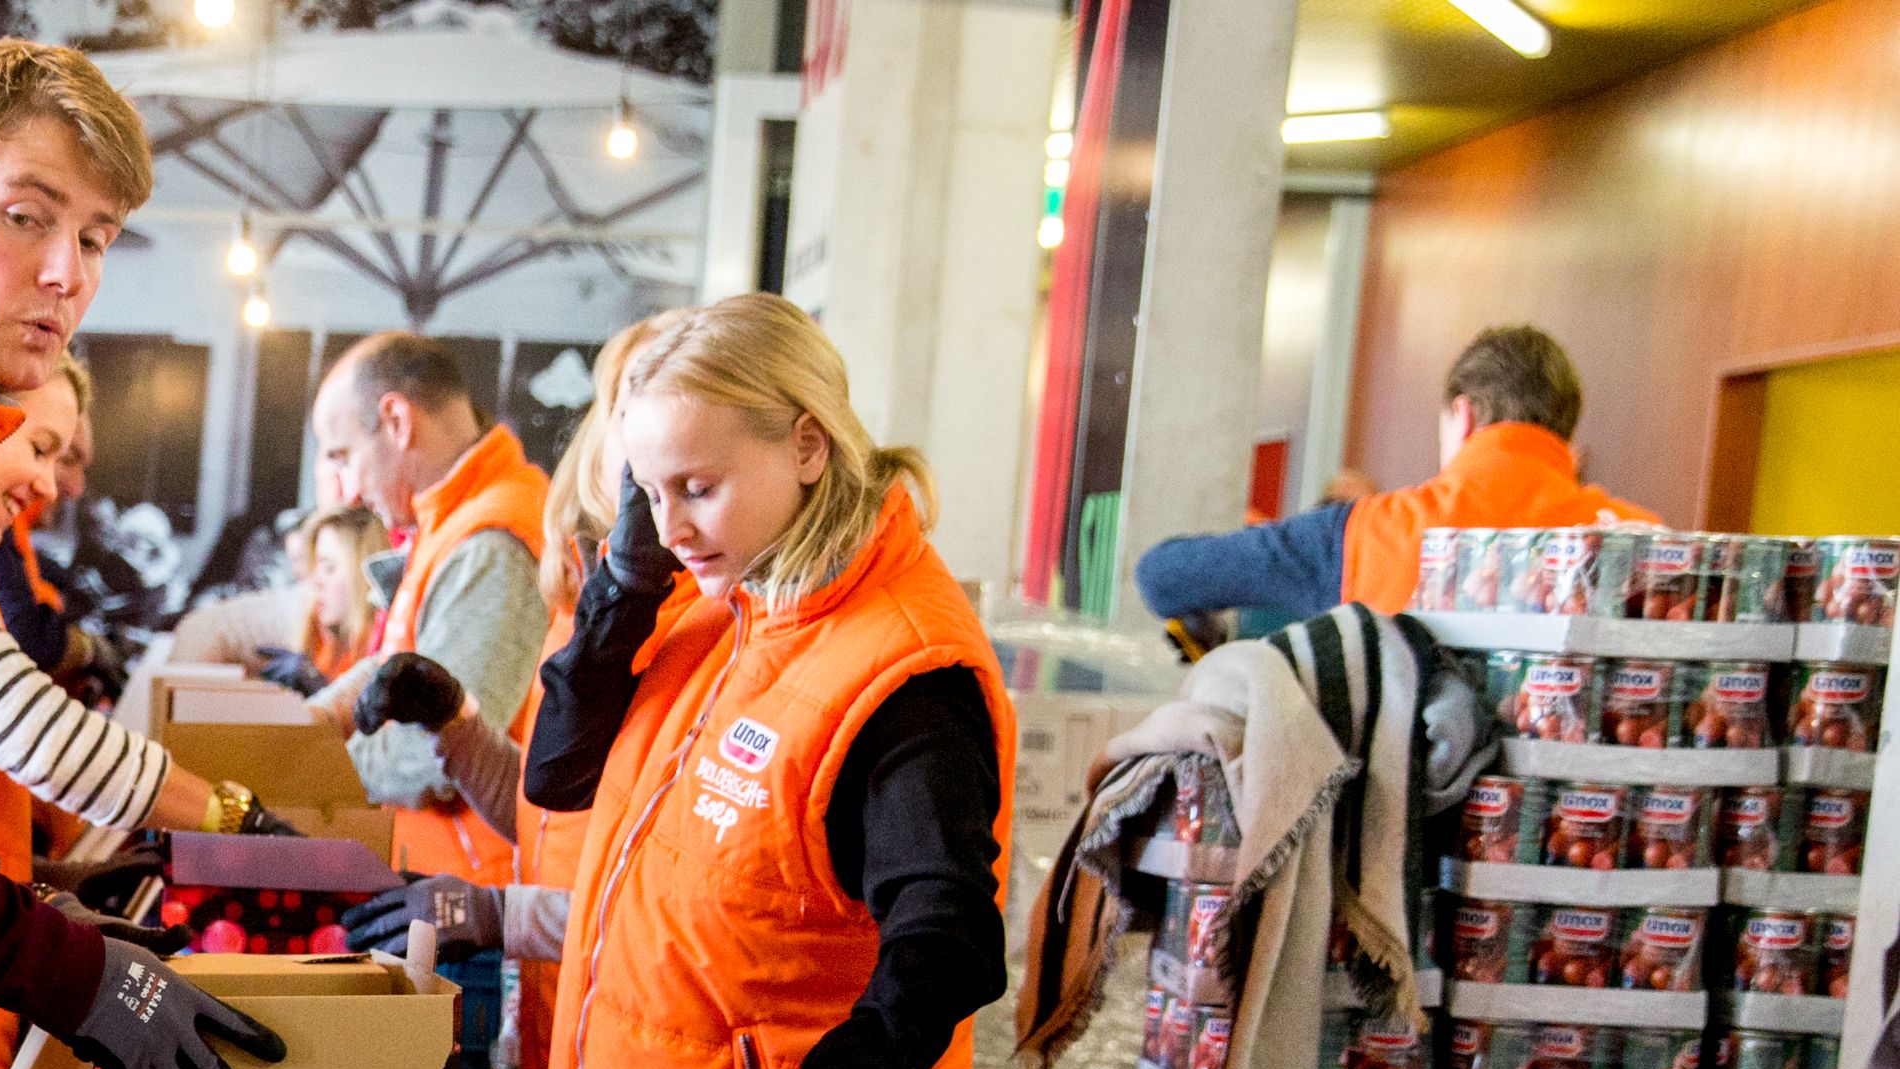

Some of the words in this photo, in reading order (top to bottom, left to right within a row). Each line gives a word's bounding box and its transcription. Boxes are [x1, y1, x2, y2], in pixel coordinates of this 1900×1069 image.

[733, 721, 772, 753] unox
[1563, 792, 1610, 808] unox
[139, 977, 168, 1024] M-SAFE
